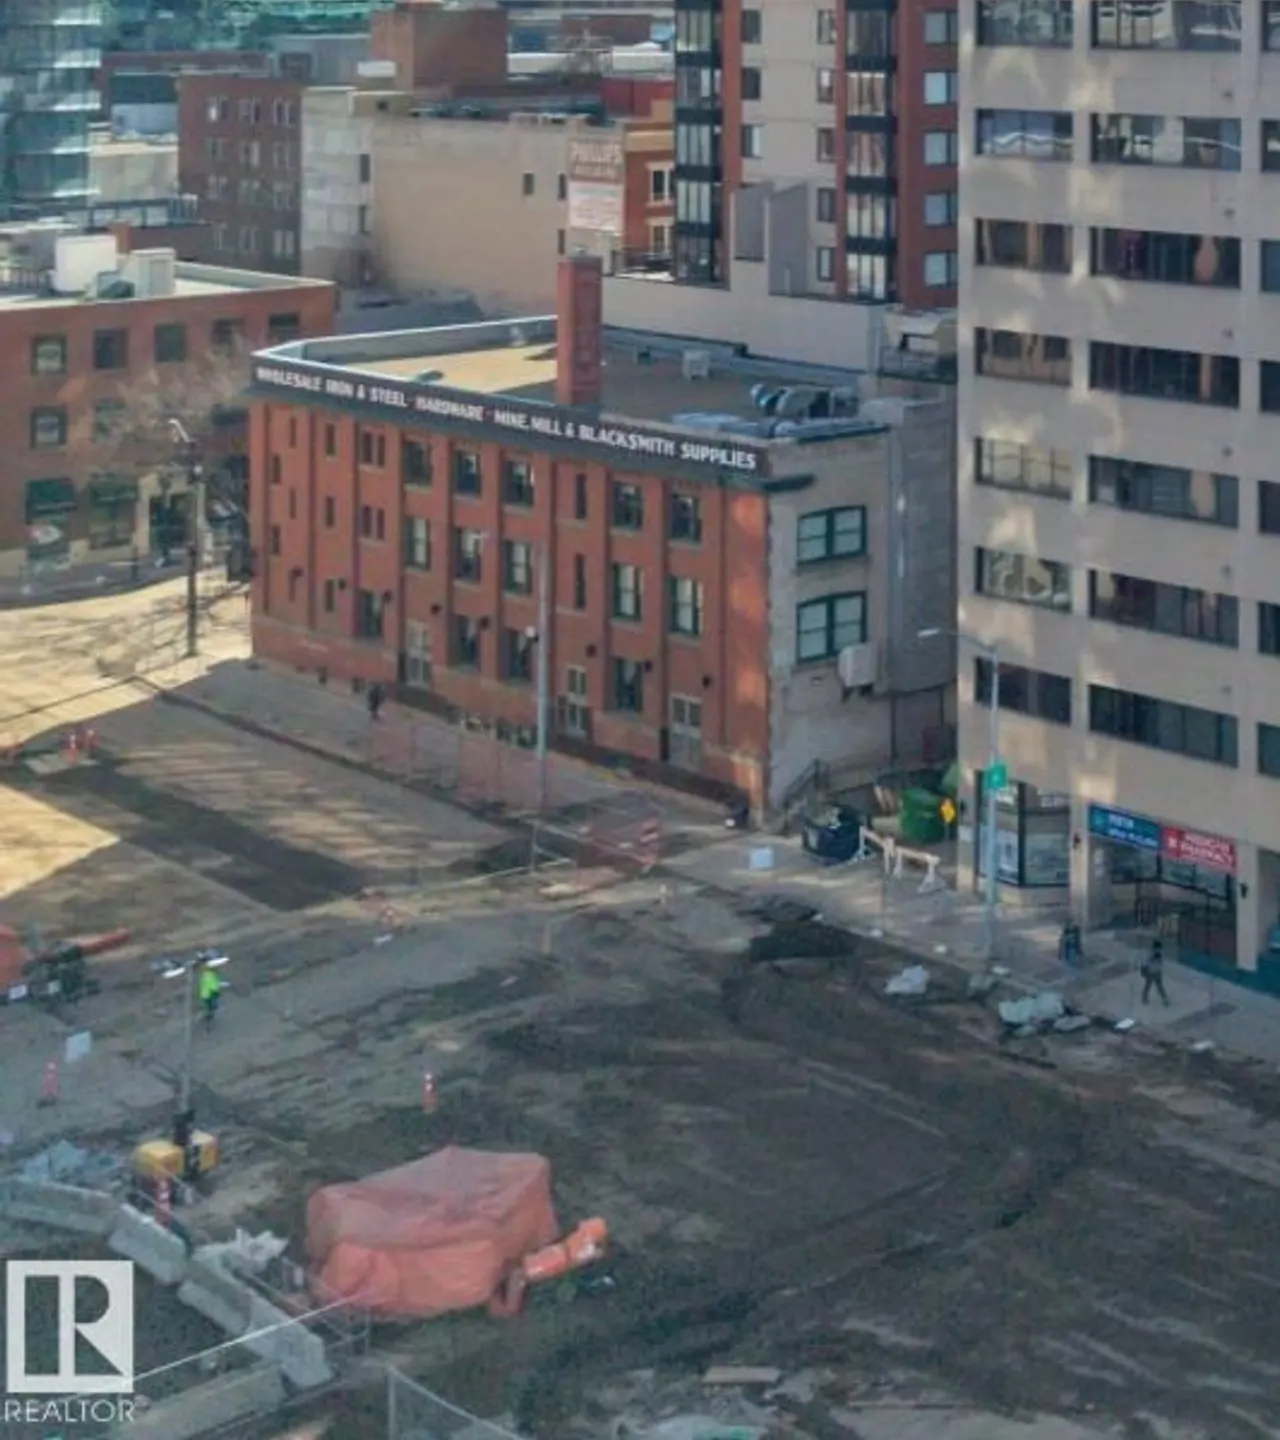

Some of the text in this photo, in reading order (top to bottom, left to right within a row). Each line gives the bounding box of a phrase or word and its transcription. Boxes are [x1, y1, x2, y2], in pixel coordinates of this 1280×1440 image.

[256, 366, 322, 392] WHOLESALE
[325, 378, 354, 398] IRON
[369, 387, 407, 408] STEEL
[415, 395, 484, 421] HARDWARE
[531, 417, 562, 437] MILL
[578, 424, 675, 457] BLACKSMITH
[680, 443, 757, 470] SUPPLIES
